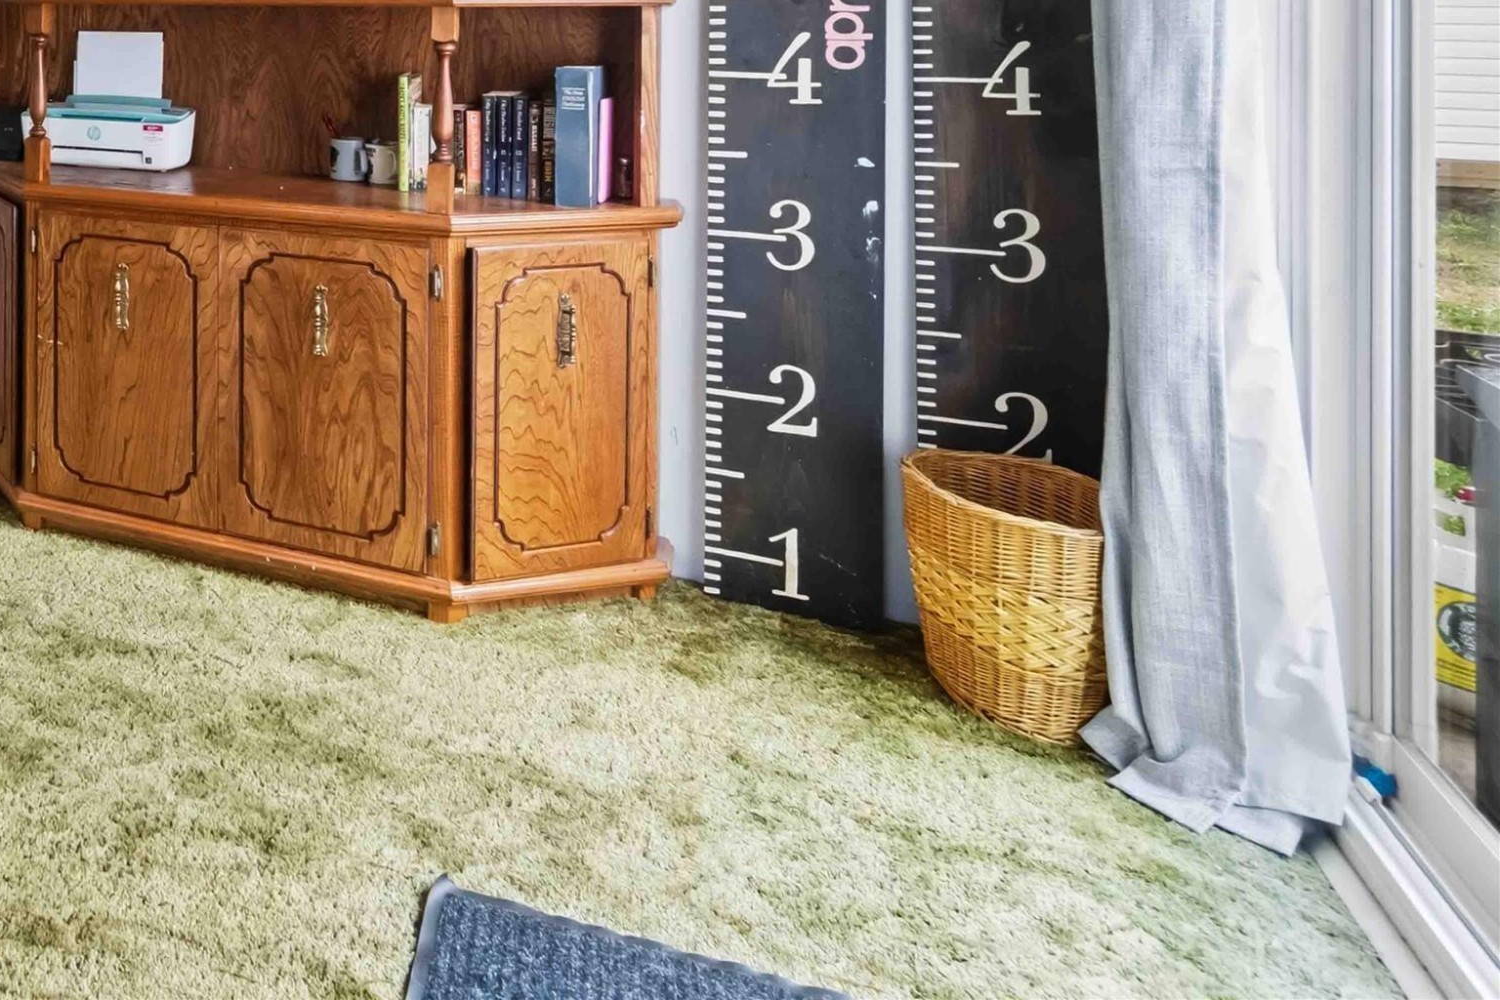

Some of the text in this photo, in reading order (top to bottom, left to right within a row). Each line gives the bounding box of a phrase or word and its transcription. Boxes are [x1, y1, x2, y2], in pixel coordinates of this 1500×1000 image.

[767, 32, 822, 105] 4
[982, 40, 1042, 116] 4
[766, 200, 815, 271] 3
[989, 208, 1046, 284] 3
[766, 364, 818, 438] 2
[994, 391, 1052, 465] 2
[768, 527, 810, 601] 1
